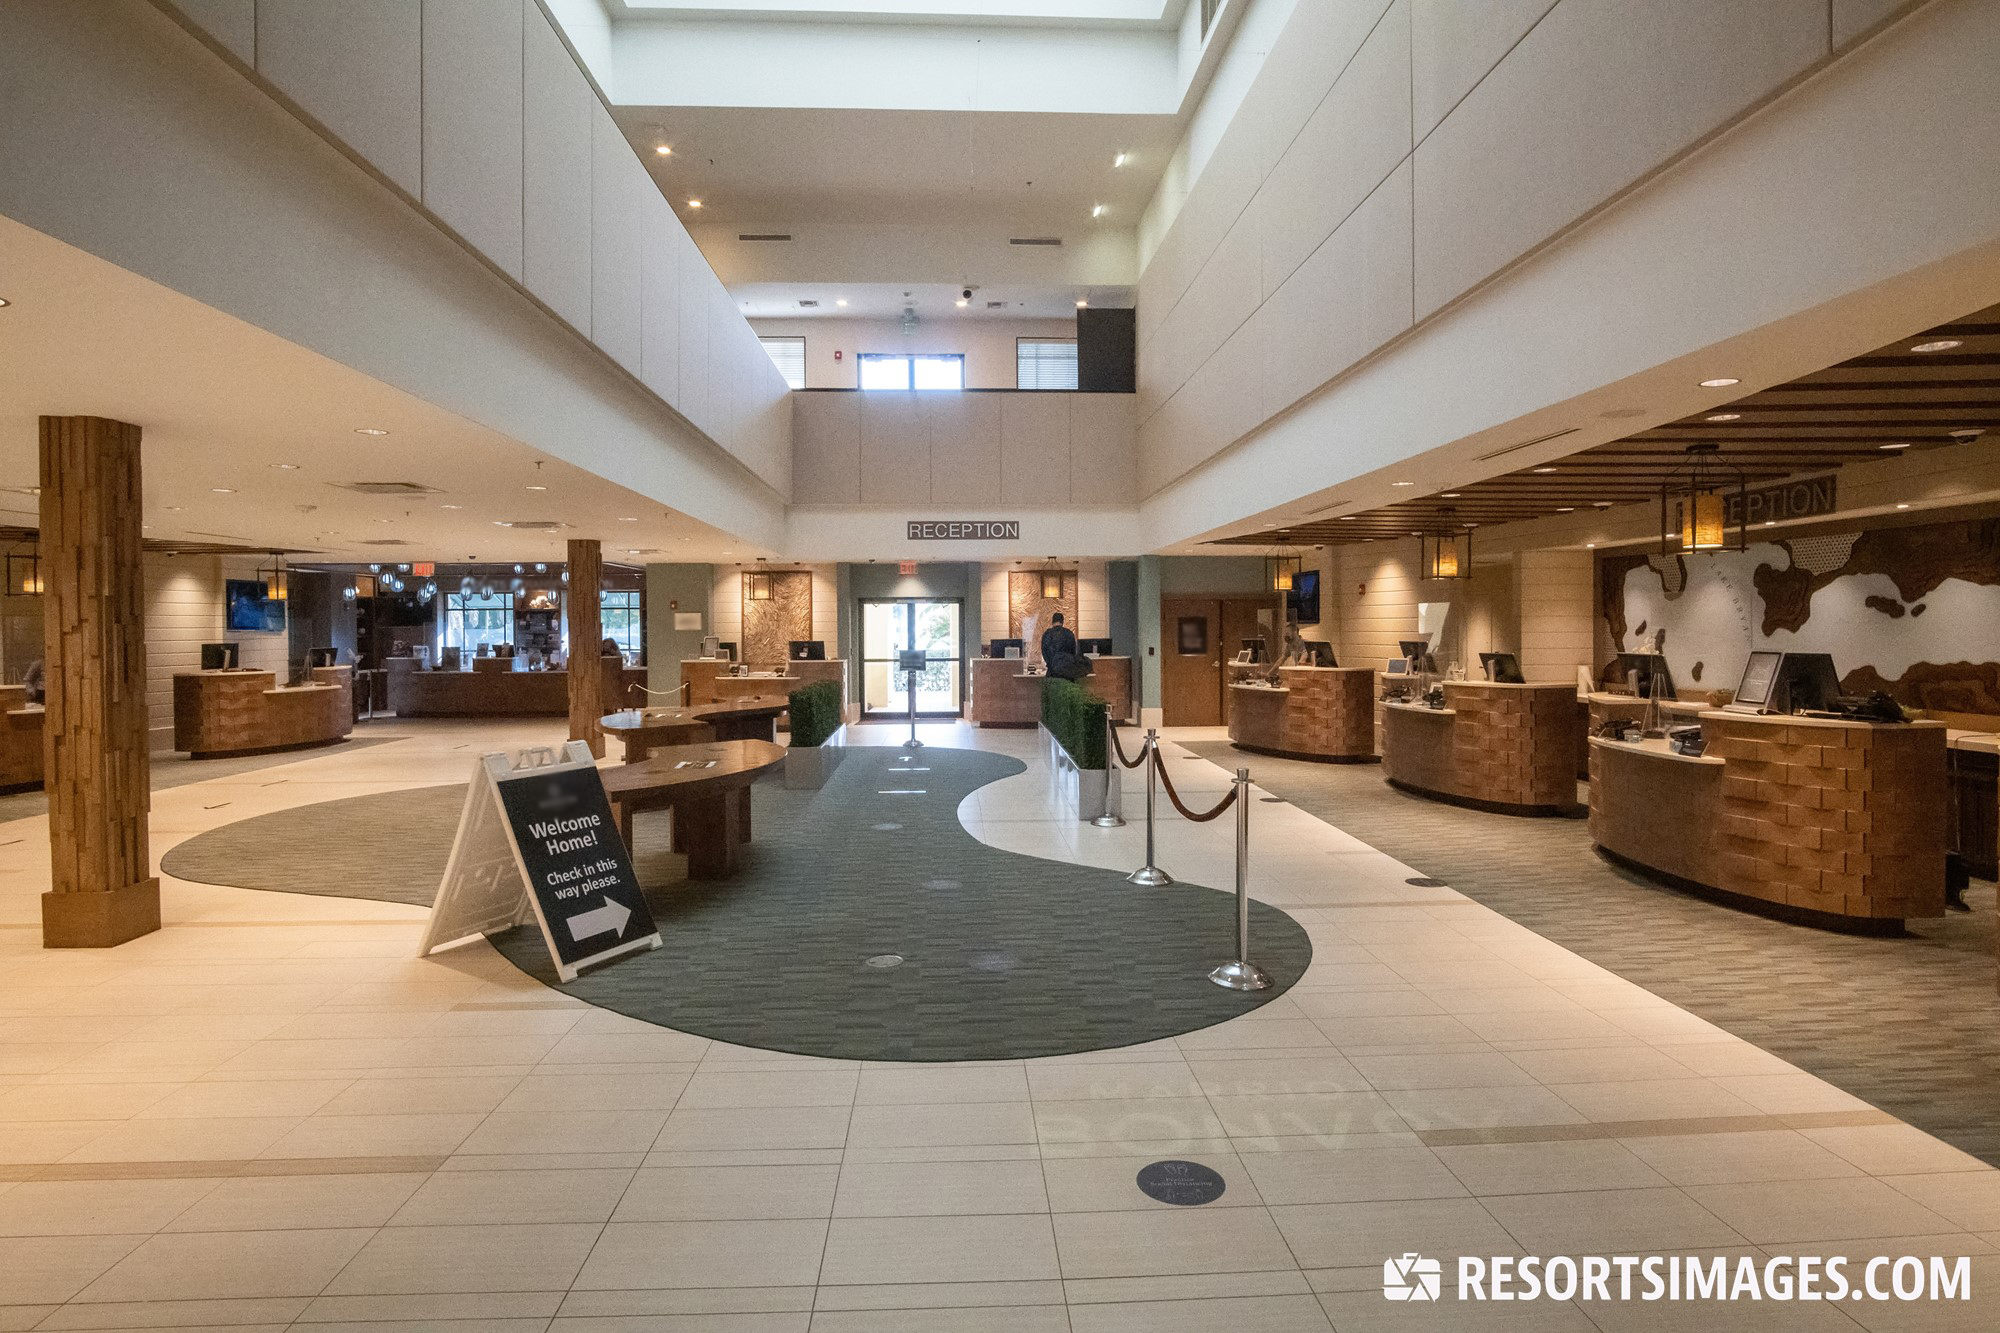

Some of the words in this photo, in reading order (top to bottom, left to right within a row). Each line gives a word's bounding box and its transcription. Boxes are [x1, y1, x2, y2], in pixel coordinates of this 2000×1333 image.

[909, 522, 1018, 538] RECEPTION
[528, 813, 601, 839] Welcome
[545, 830, 599, 856] Home!
[546, 864, 584, 887] Check
[582, 863, 597, 877] in
[596, 857, 618, 874] this
[554, 886, 580, 900] way
[581, 874, 621, 896] please.
